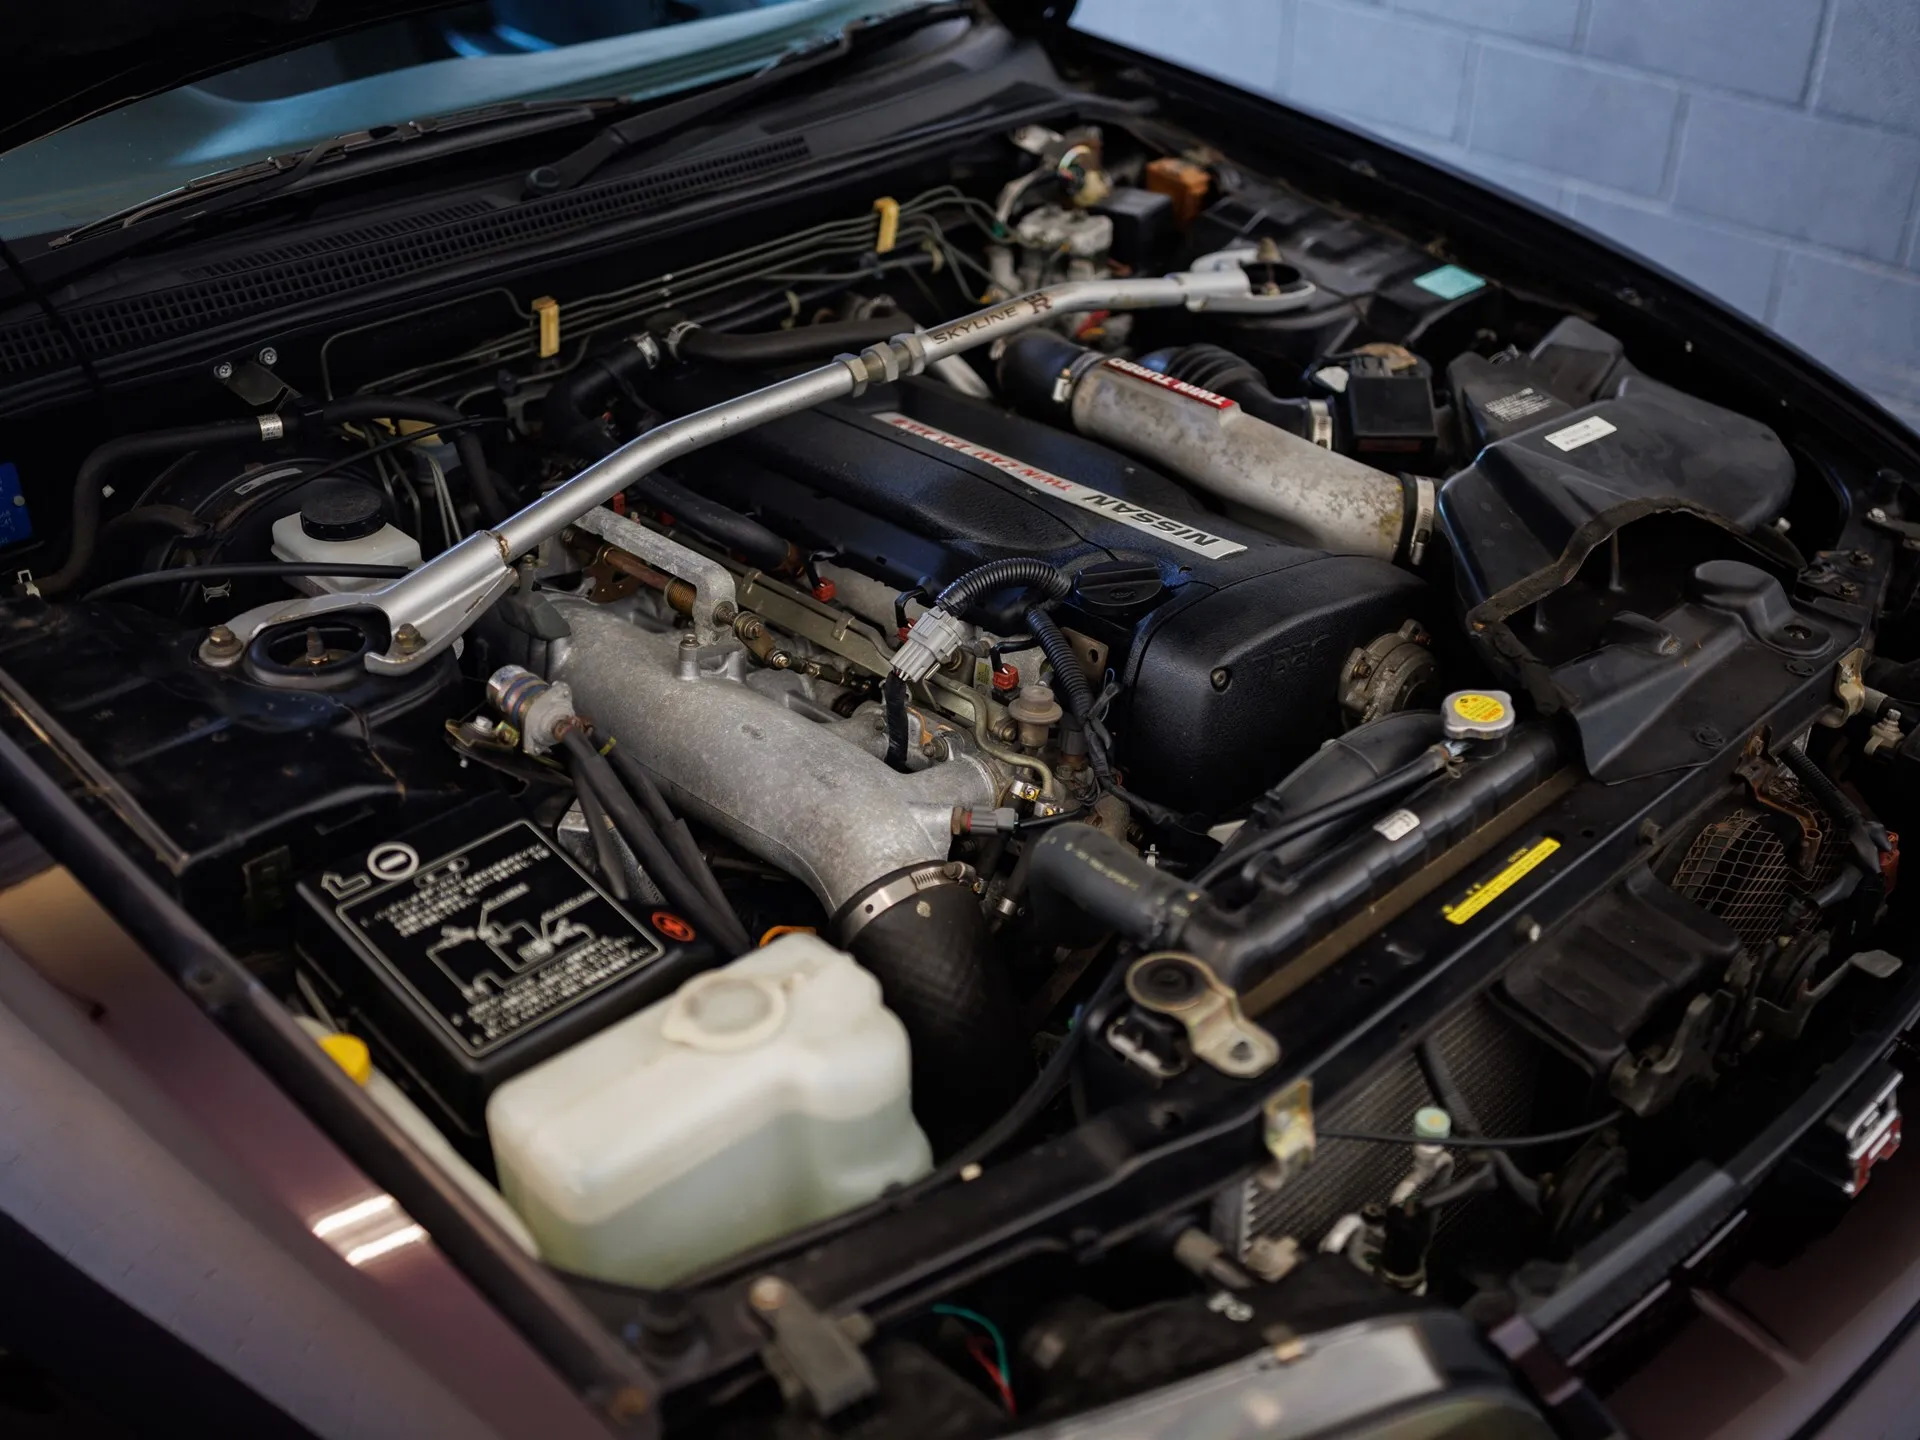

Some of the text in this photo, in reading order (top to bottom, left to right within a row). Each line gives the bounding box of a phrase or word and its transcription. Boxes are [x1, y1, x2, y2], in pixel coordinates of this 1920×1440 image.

[933, 306, 1018, 345] SKYLINE
[1107, 357, 1228, 405] TWIN TURBO
[1019, 468, 1073, 491] TWIN
[1082, 494, 1220, 547] NISSAN
